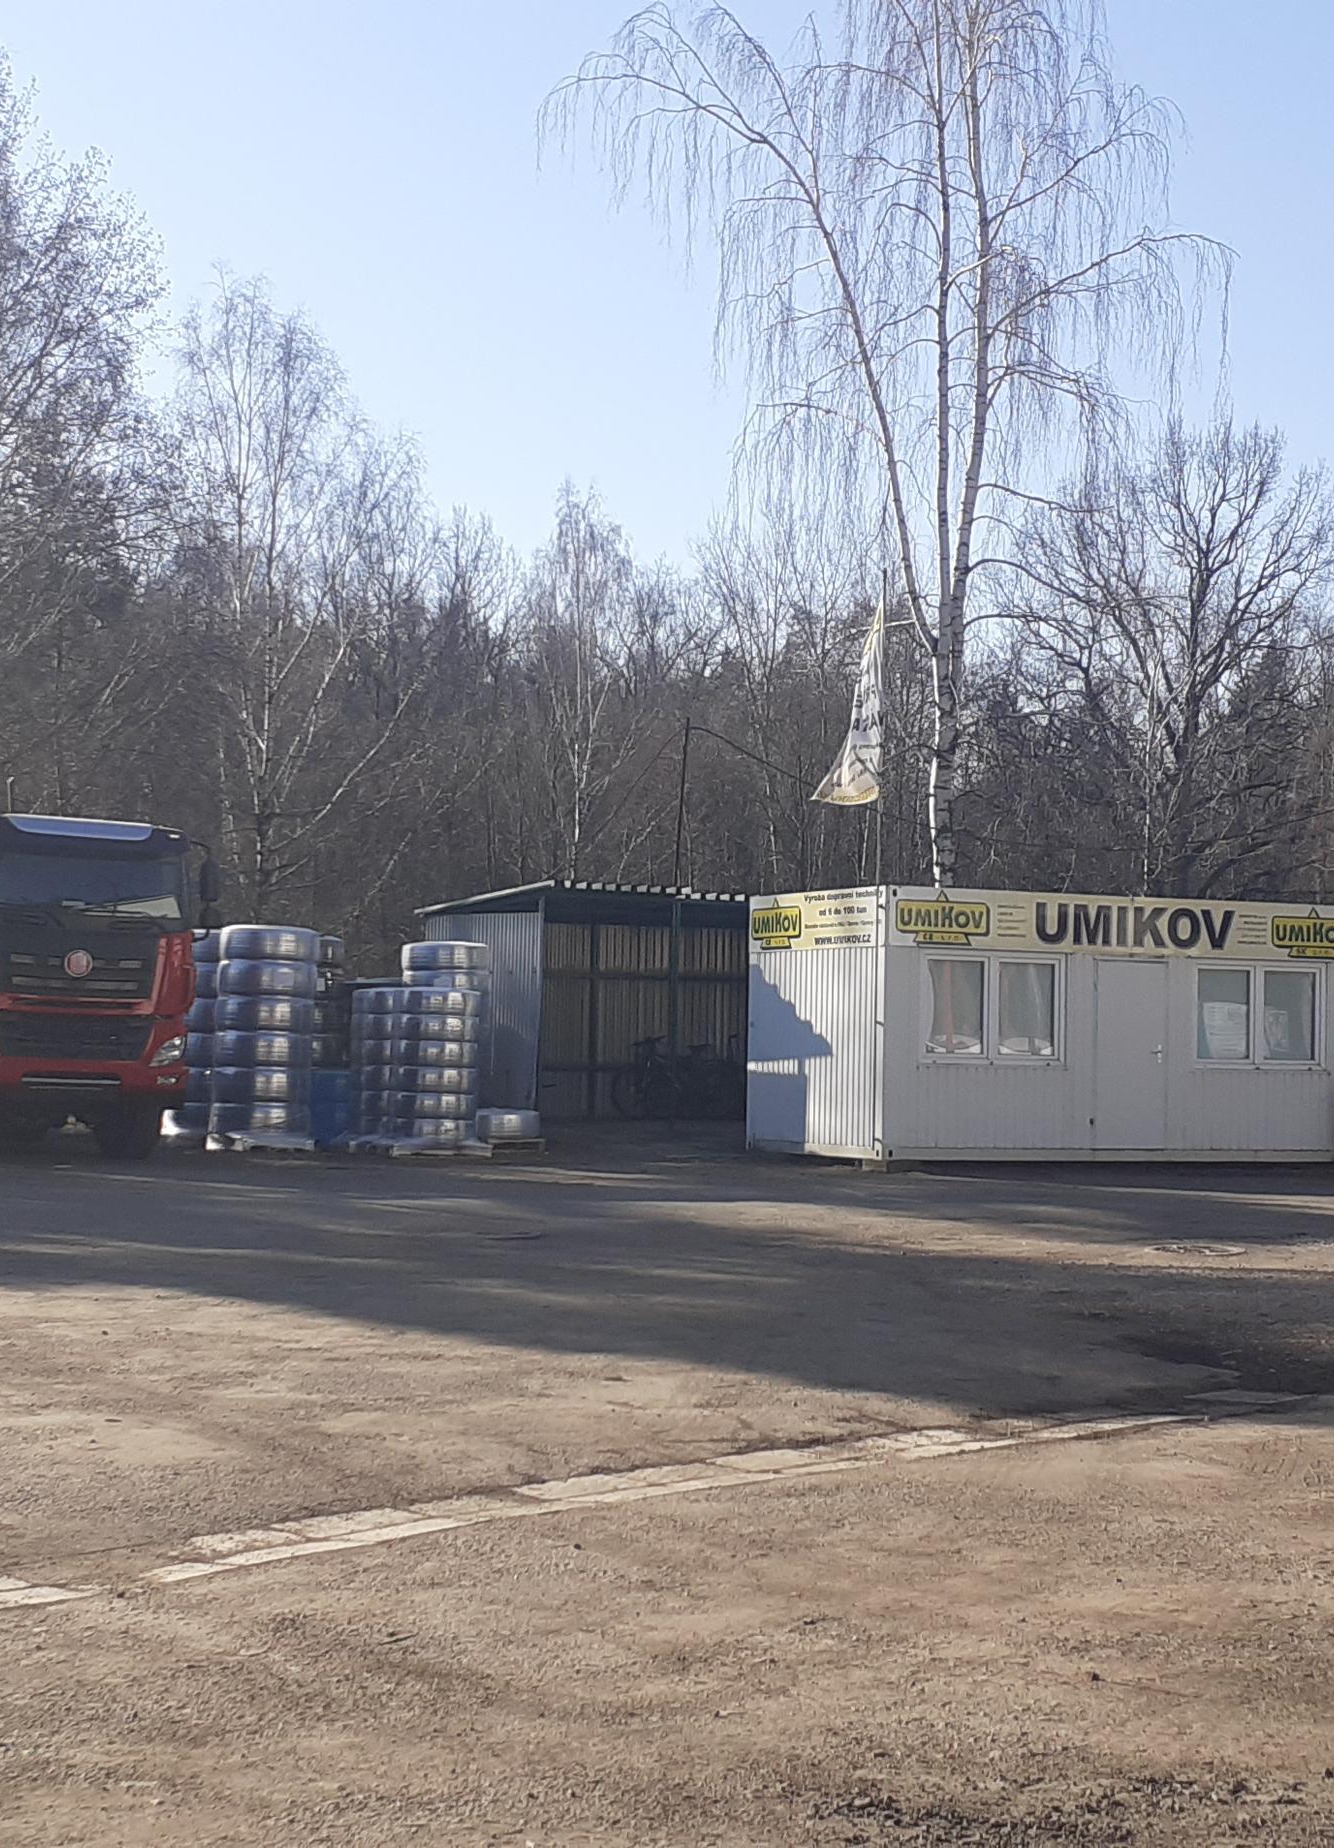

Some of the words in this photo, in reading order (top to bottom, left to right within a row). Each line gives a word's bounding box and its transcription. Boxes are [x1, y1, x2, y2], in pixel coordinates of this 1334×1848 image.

[753, 912, 798, 934] UMIKOV
[900, 905, 984, 929] UMIKOV
[1035, 901, 1236, 950] UMIKOV
